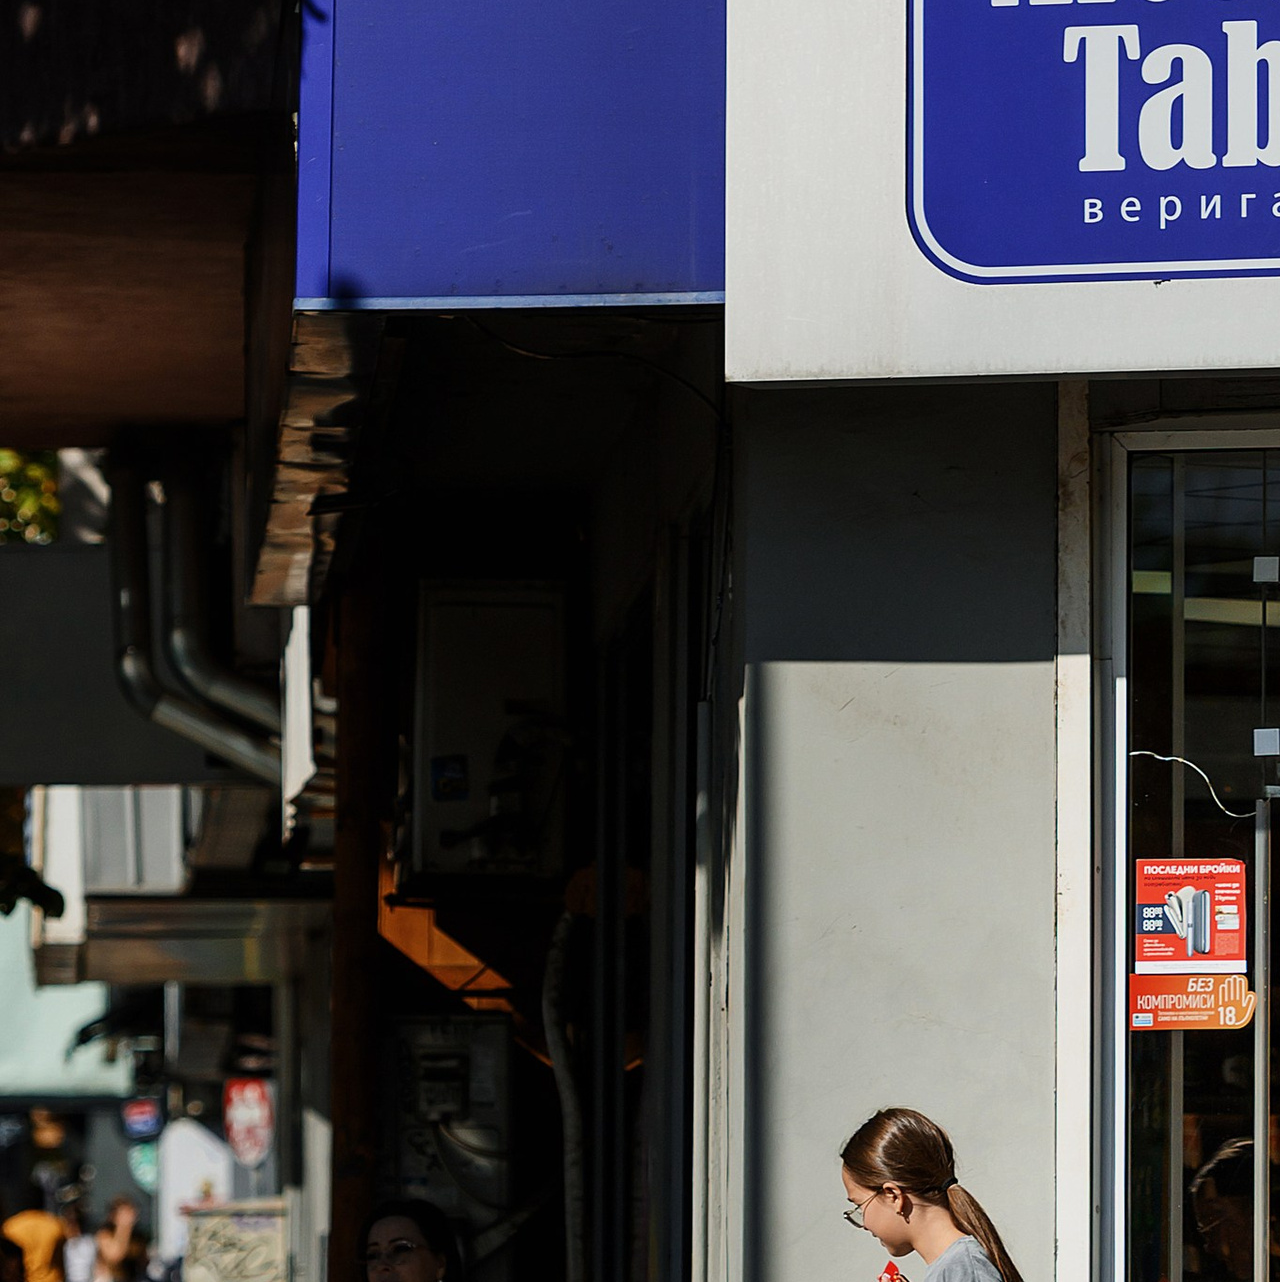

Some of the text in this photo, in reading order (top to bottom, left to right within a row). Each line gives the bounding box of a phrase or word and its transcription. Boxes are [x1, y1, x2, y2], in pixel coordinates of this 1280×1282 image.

[1144, 863, 1240, 875] ПОСЛЕДНИ БРОЙКИ
[1187, 978, 1214, 992] БЕЗ
[1137, 994, 1214, 1010] КОМПРОМИСИ
[1217, 1006, 1236, 1025] 18
